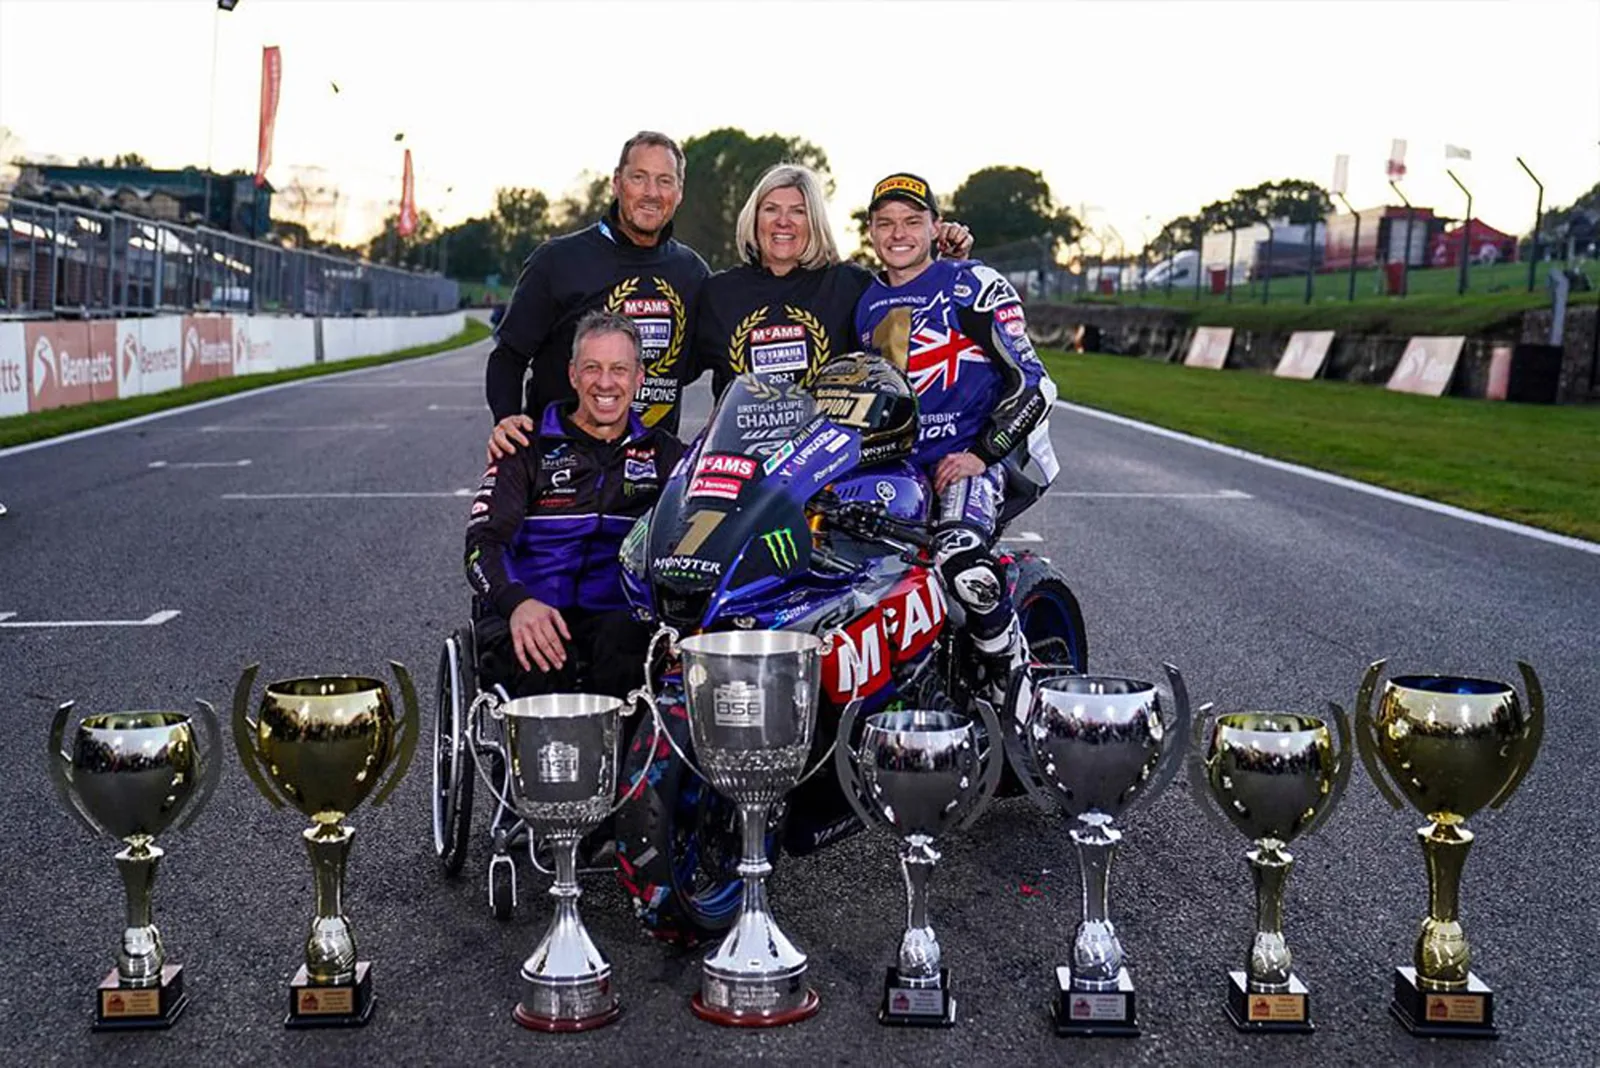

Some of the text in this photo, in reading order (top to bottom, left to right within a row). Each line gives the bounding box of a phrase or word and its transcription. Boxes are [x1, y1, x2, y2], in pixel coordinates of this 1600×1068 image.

[625, 300, 669, 313] McAMS
[751, 327, 803, 341] McAMS
[140, 345, 178, 374] Bennetts
[0, 359, 21, 393] tts
[60, 352, 113, 387] Bennetts
[768, 372, 796, 385] 2021
[776, 399, 805, 411] SUPE
[736, 410, 804, 428] CHAMPI
[672, 510, 728, 556] 1
[653, 556, 721, 576] MONSTER
[717, 701, 761, 715] BSE
